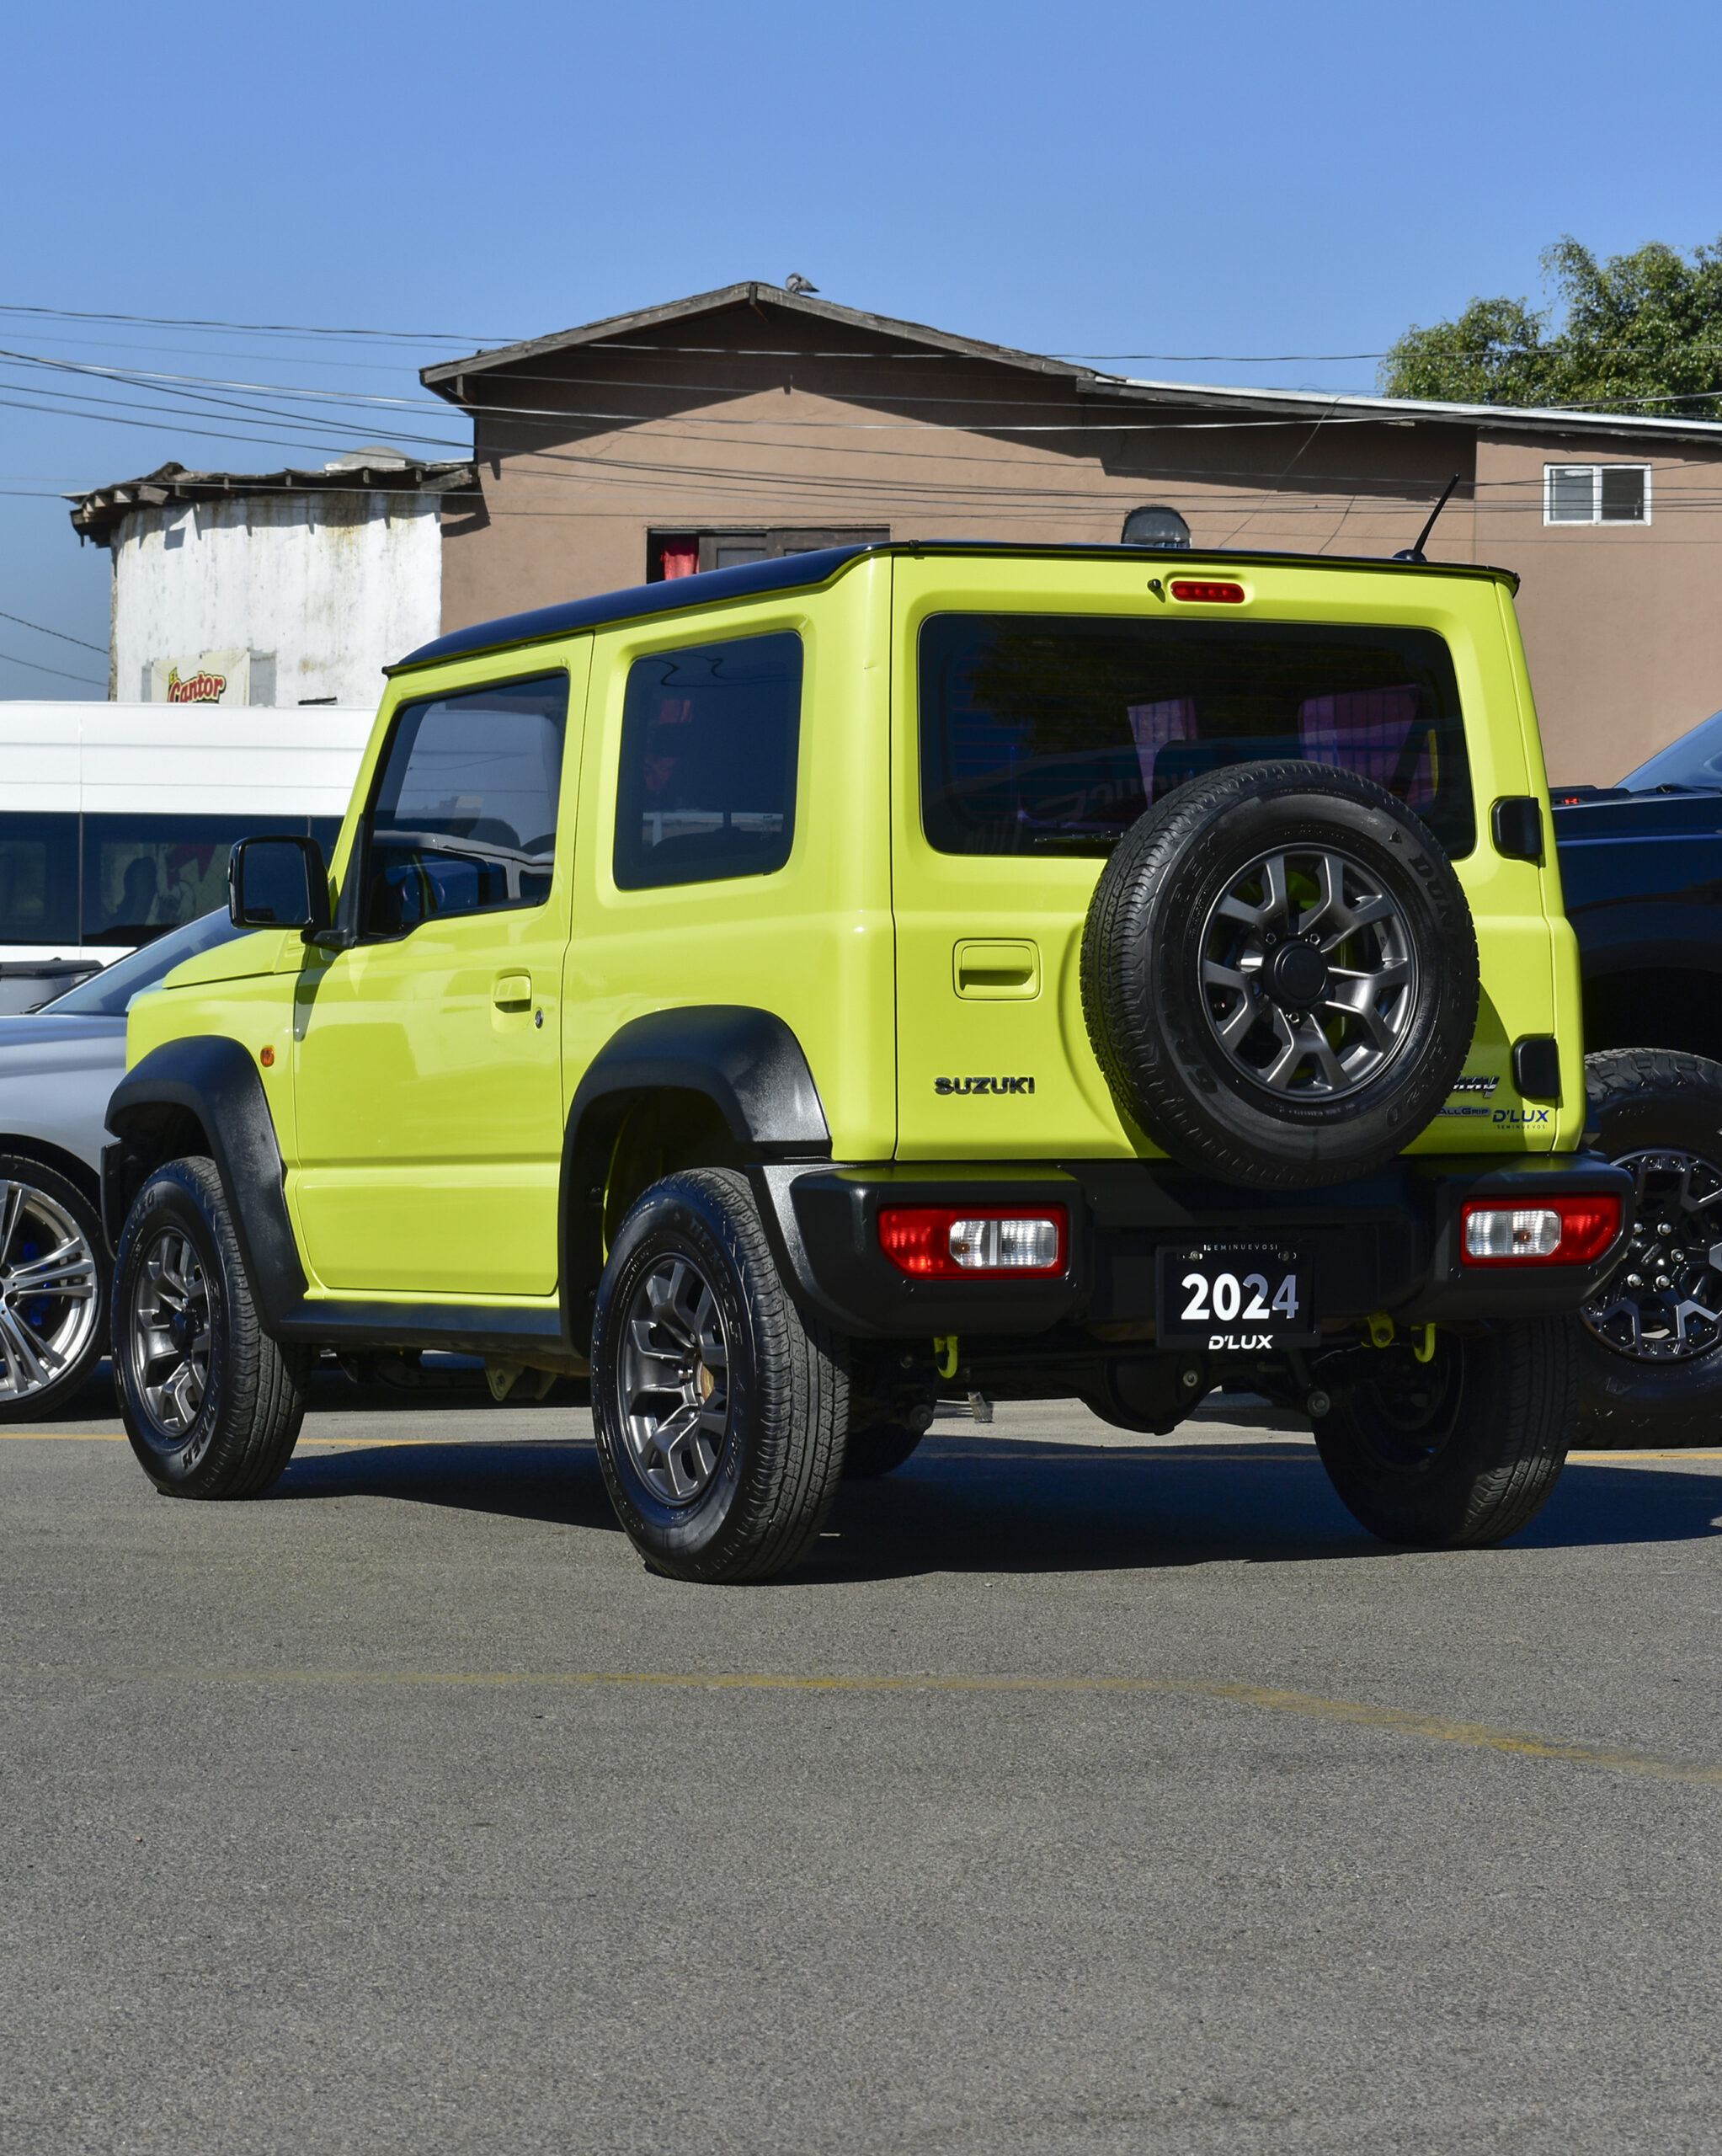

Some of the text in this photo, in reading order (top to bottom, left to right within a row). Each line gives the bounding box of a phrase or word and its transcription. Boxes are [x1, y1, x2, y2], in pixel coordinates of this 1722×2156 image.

[934, 1076, 1035, 1095] SUZUKI
[1492, 1109, 1549, 1123] D'LUX
[1181, 1273, 1299, 1321] 2024
[1208, 1335, 1273, 1350] D'LUX
